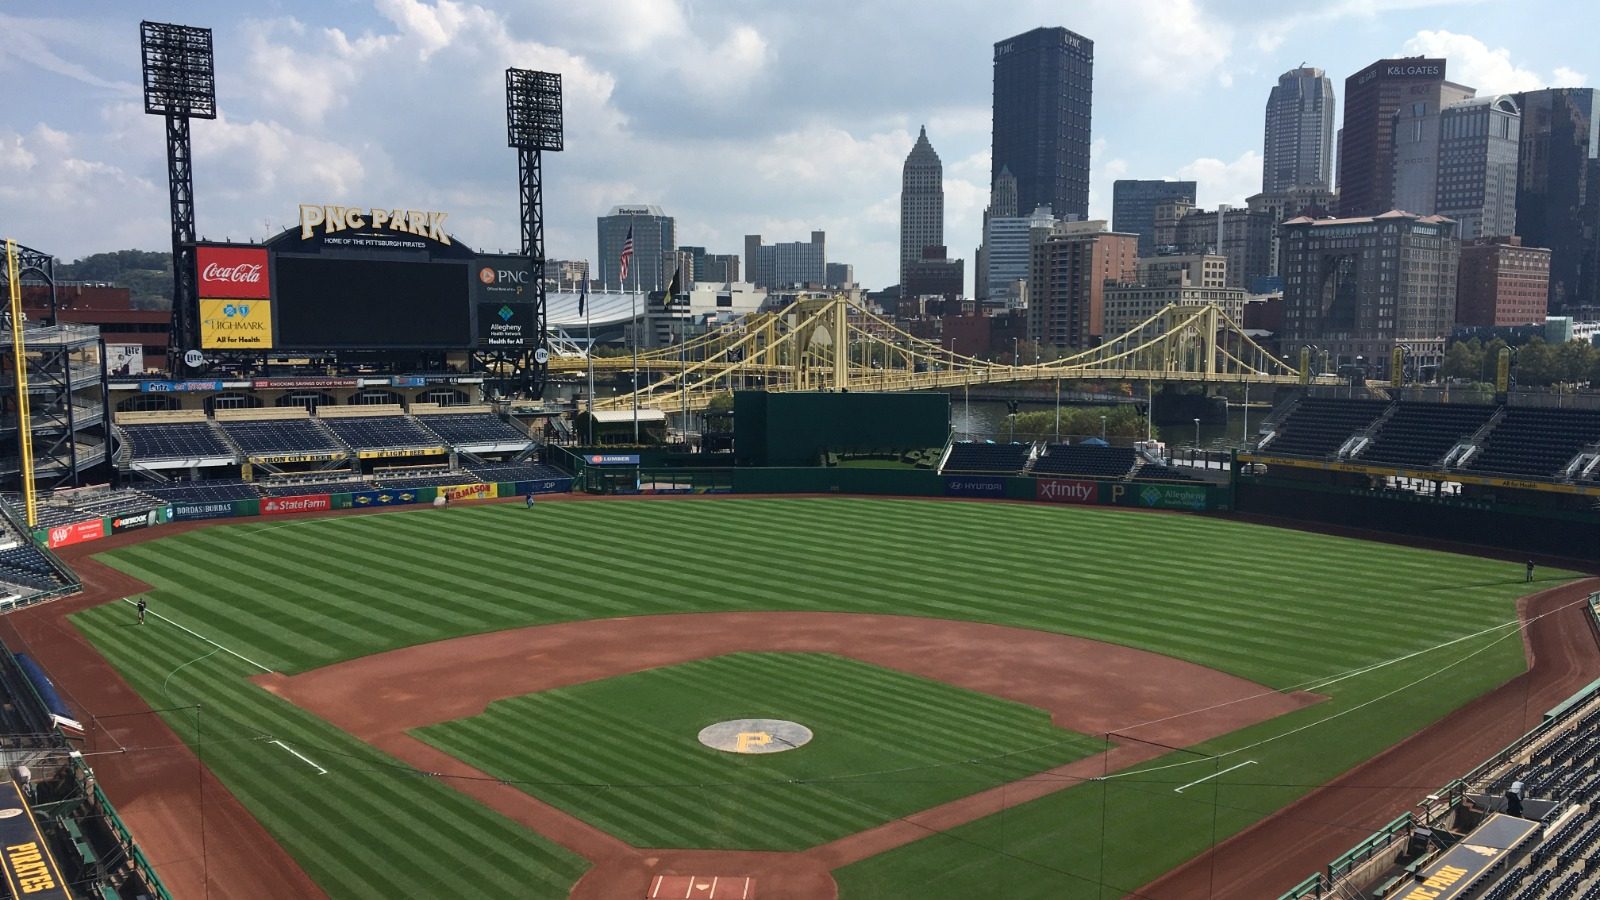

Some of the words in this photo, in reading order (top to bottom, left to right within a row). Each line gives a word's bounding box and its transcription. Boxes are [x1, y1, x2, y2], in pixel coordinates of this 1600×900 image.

[1064, 33, 1081, 49] UPMC
[1387, 66, 1406, 75] K&L
[1407, 66, 1439, 75] GATES
[300, 204, 366, 241] PNC
[371, 208, 451, 246] PARK
[365, 239, 402, 247] PITTSBURGH
[203, 262, 262, 283] Coca-Cola
[497, 270, 529, 284] PNC
[211, 320, 264, 330] HIGHMARK
[490, 323, 522, 332] Allegheny
[187, 354, 202, 363] Lite
[965, 482, 1002, 490] HYUNDAI
[1041, 481, 1093, 501] xfinity
[1112, 485, 1125, 502] P
[1165, 490, 1206, 501] Allegheny
[177, 506, 203, 515] BORDAS
[6, 841, 55, 893] PIRATES
[1423, 865, 1468, 891] PARK
